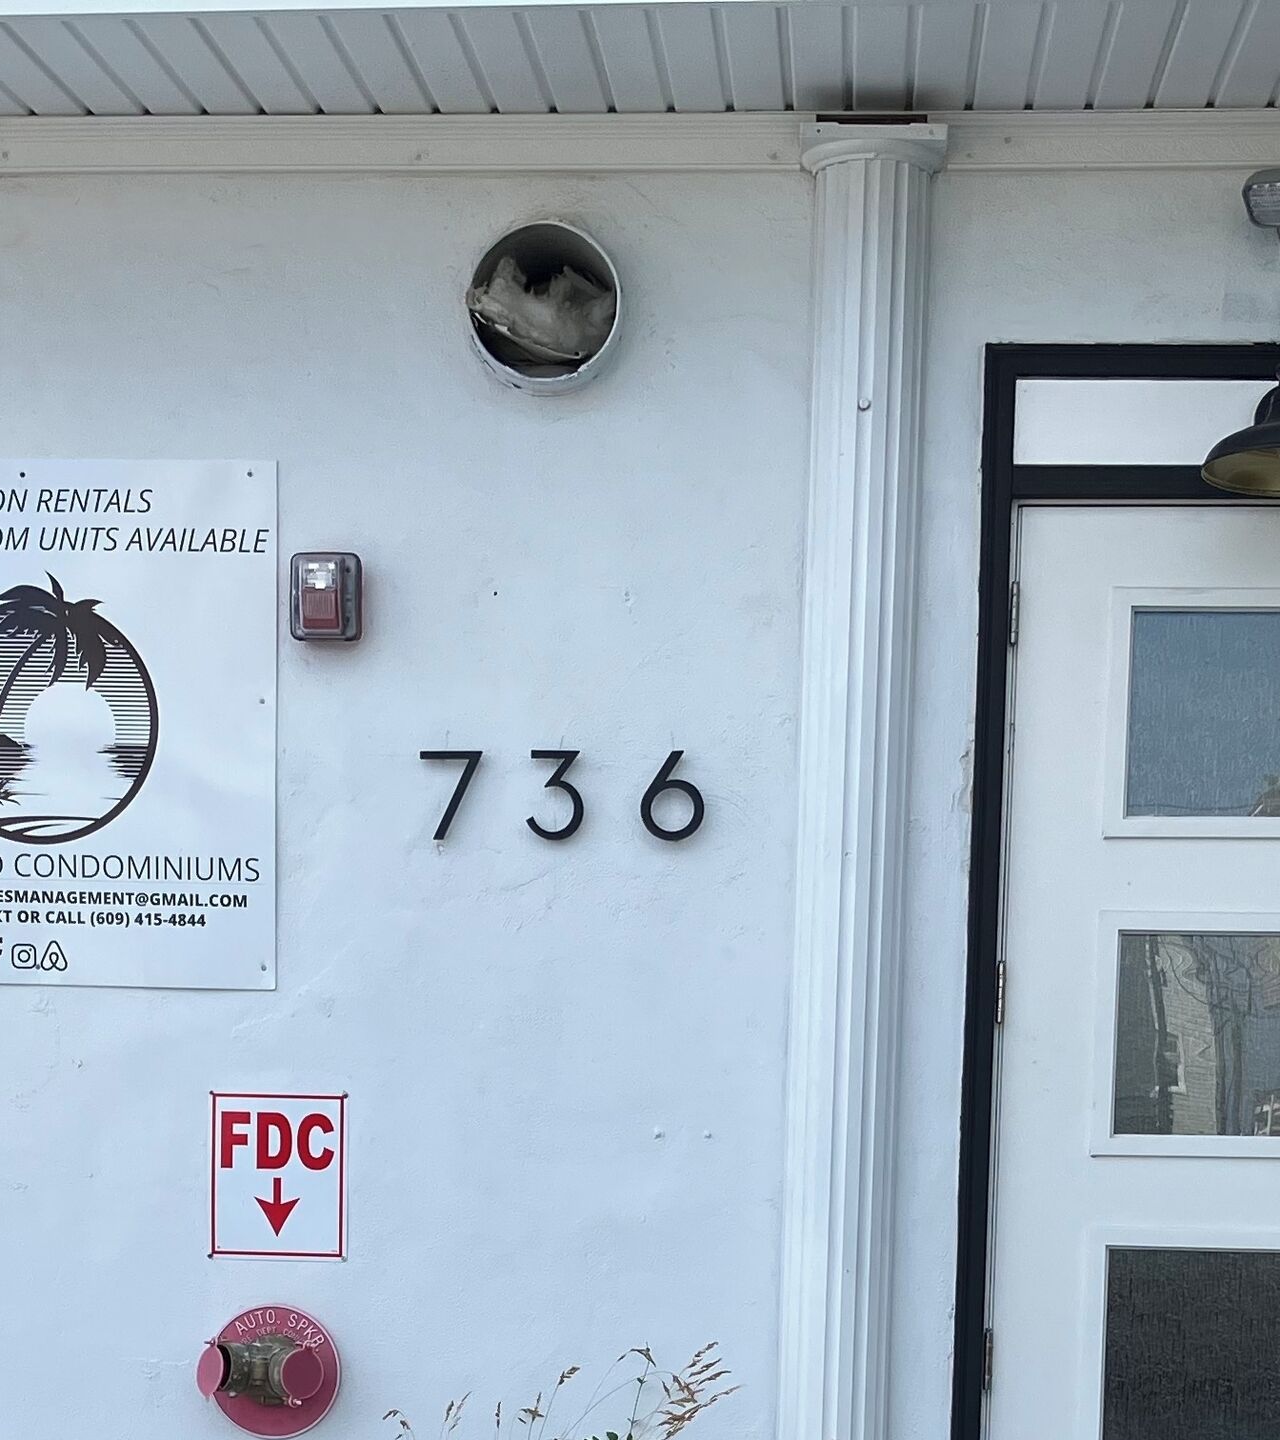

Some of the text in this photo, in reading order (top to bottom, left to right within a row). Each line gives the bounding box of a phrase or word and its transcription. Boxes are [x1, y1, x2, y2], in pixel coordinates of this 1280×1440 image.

[36, 488, 153, 513] RENTALS
[39, 526, 120, 551] UNITS
[125, 527, 270, 554] AVAILABLE
[419, 749, 705, 842] 736
[14, 853, 260, 883] CONDOMINIUMS
[17, 909, 42, 924] OR
[45, 910, 86, 925] CALL
[90, 911, 130, 928] (609)
[133, 912, 207, 927] 415-4844
[220, 1111, 335, 1171] FDC
[234, 1309, 281, 1336] AUTO.
